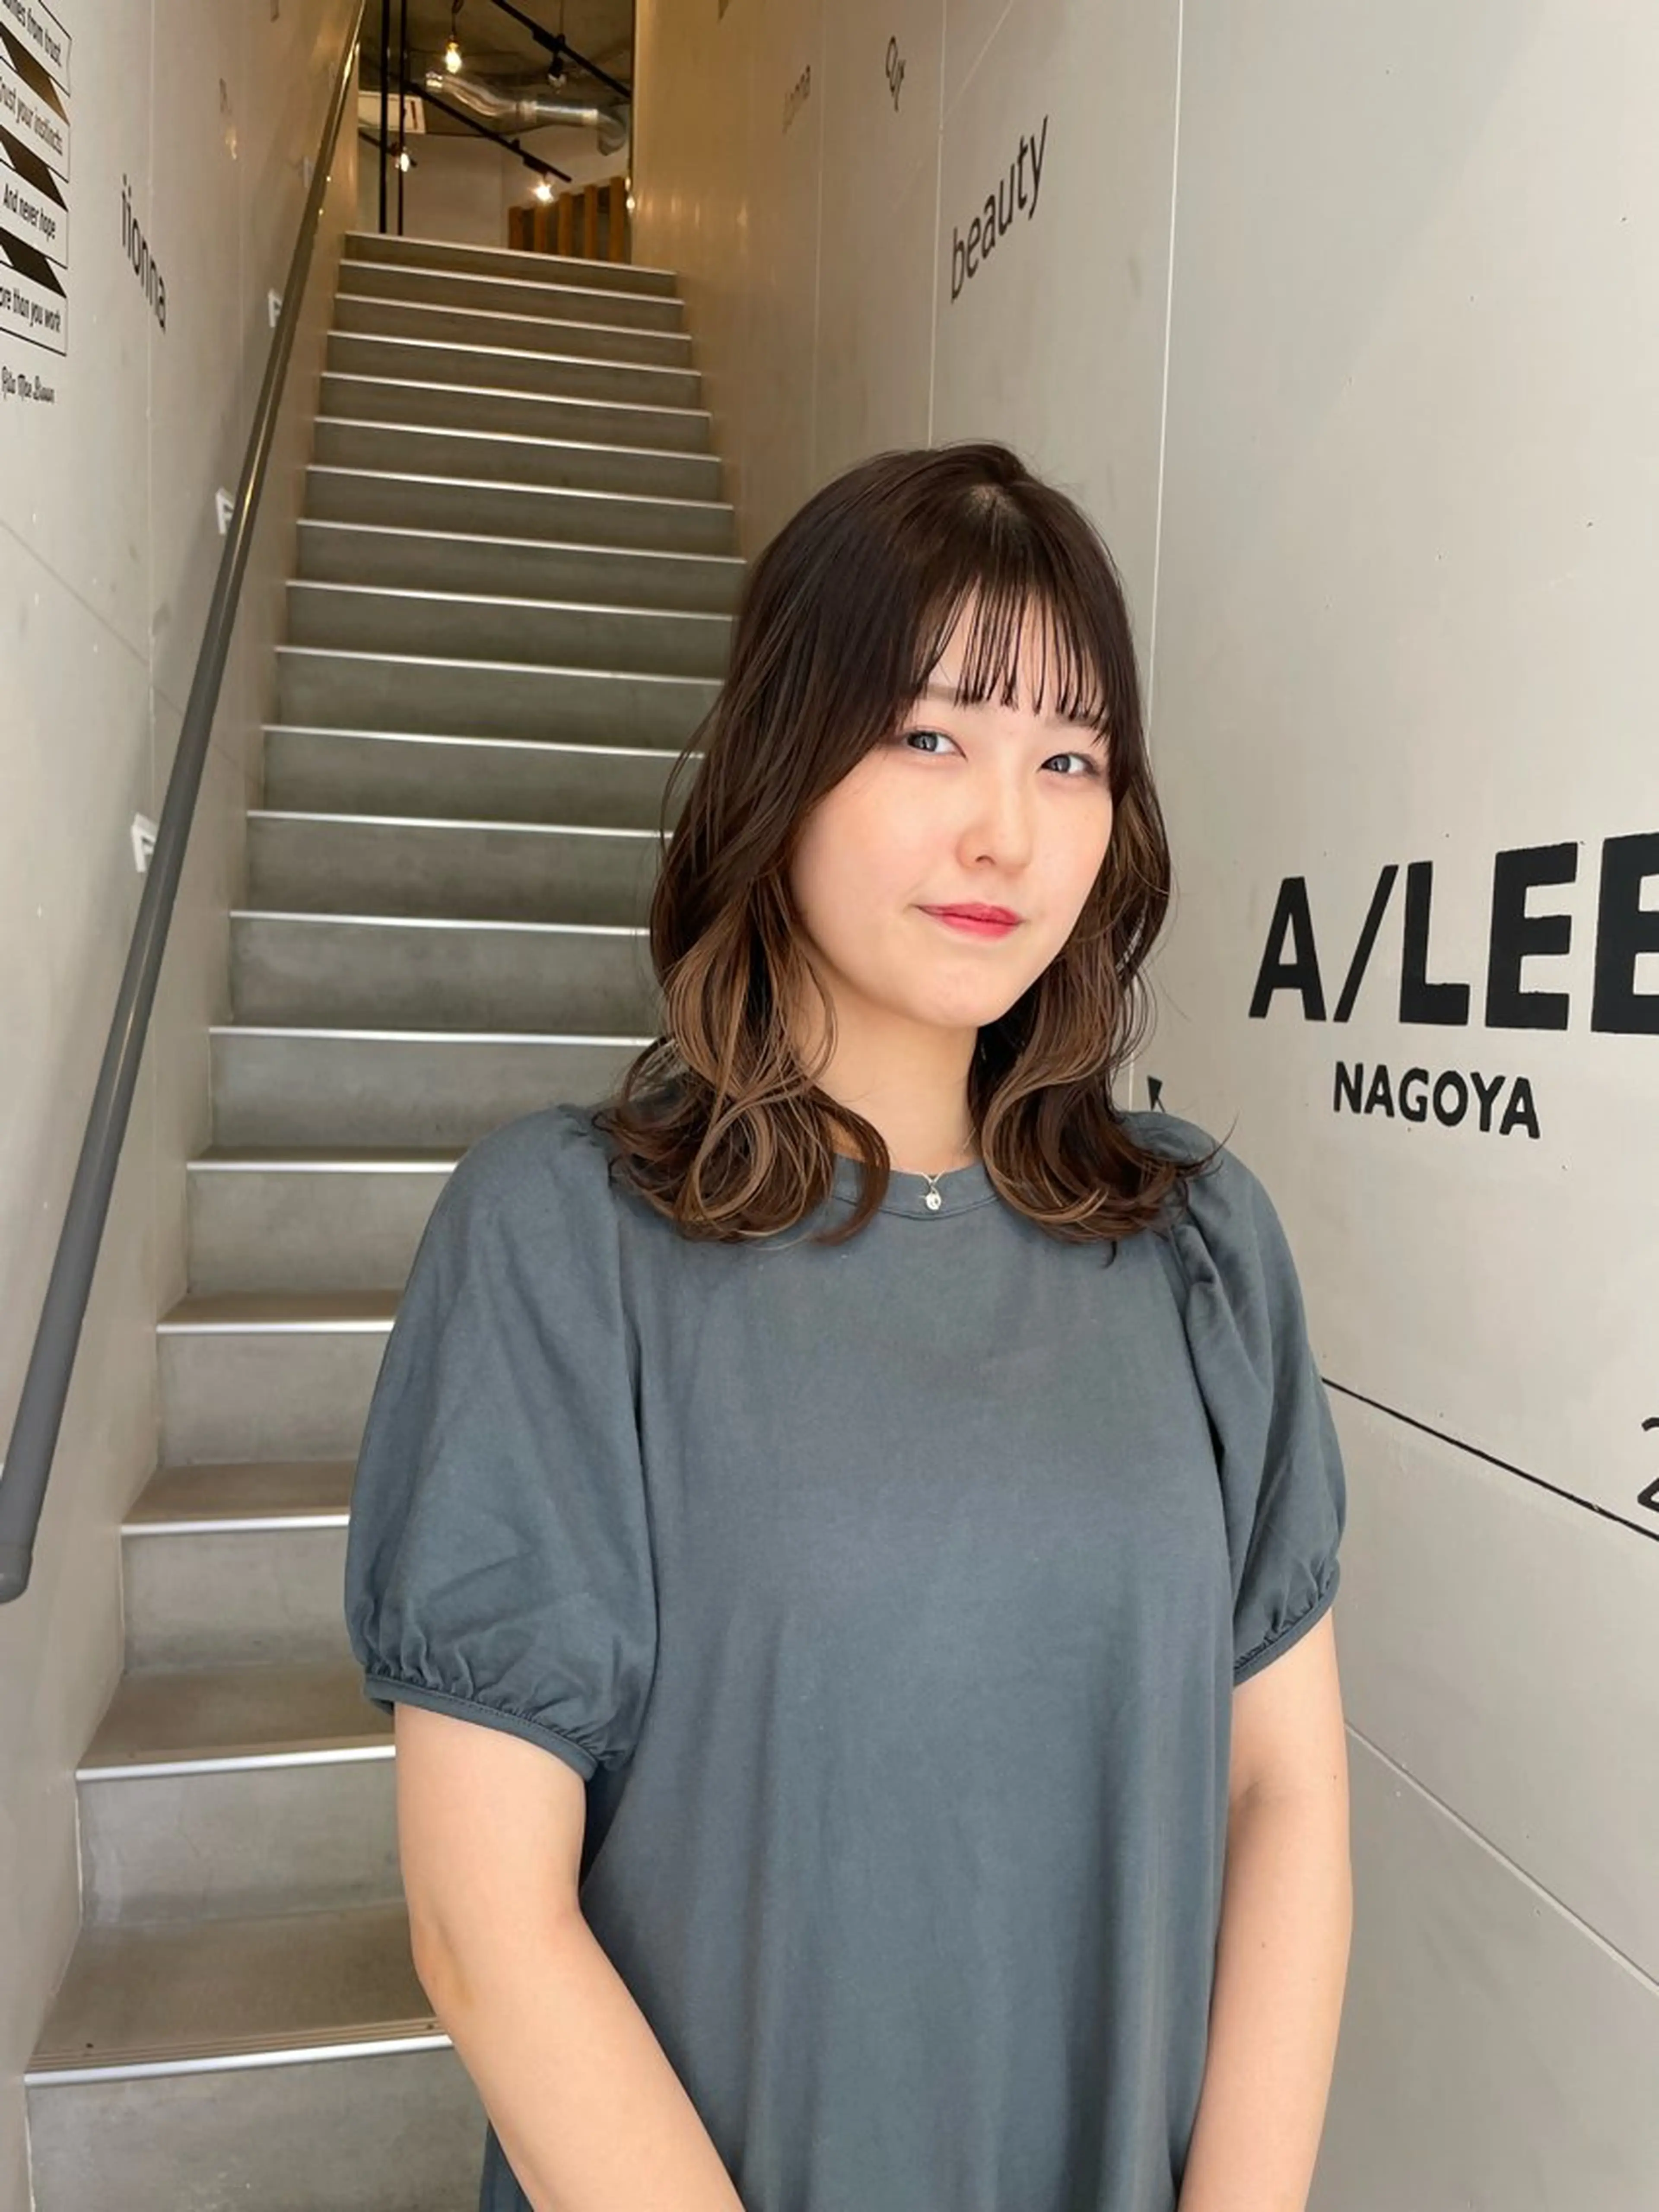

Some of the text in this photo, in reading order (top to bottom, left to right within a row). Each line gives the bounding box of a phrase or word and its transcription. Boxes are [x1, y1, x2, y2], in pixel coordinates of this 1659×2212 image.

[27, 7, 43, 47] from
[0, 75, 16, 114] rust
[16, 97, 33, 128] your
[3, 183, 55, 242] And never hope
[951, 115, 1048, 304] beauty
[0, 286, 60, 332] ore than you work
[1333, 1061, 1541, 1139] NAGOYA
